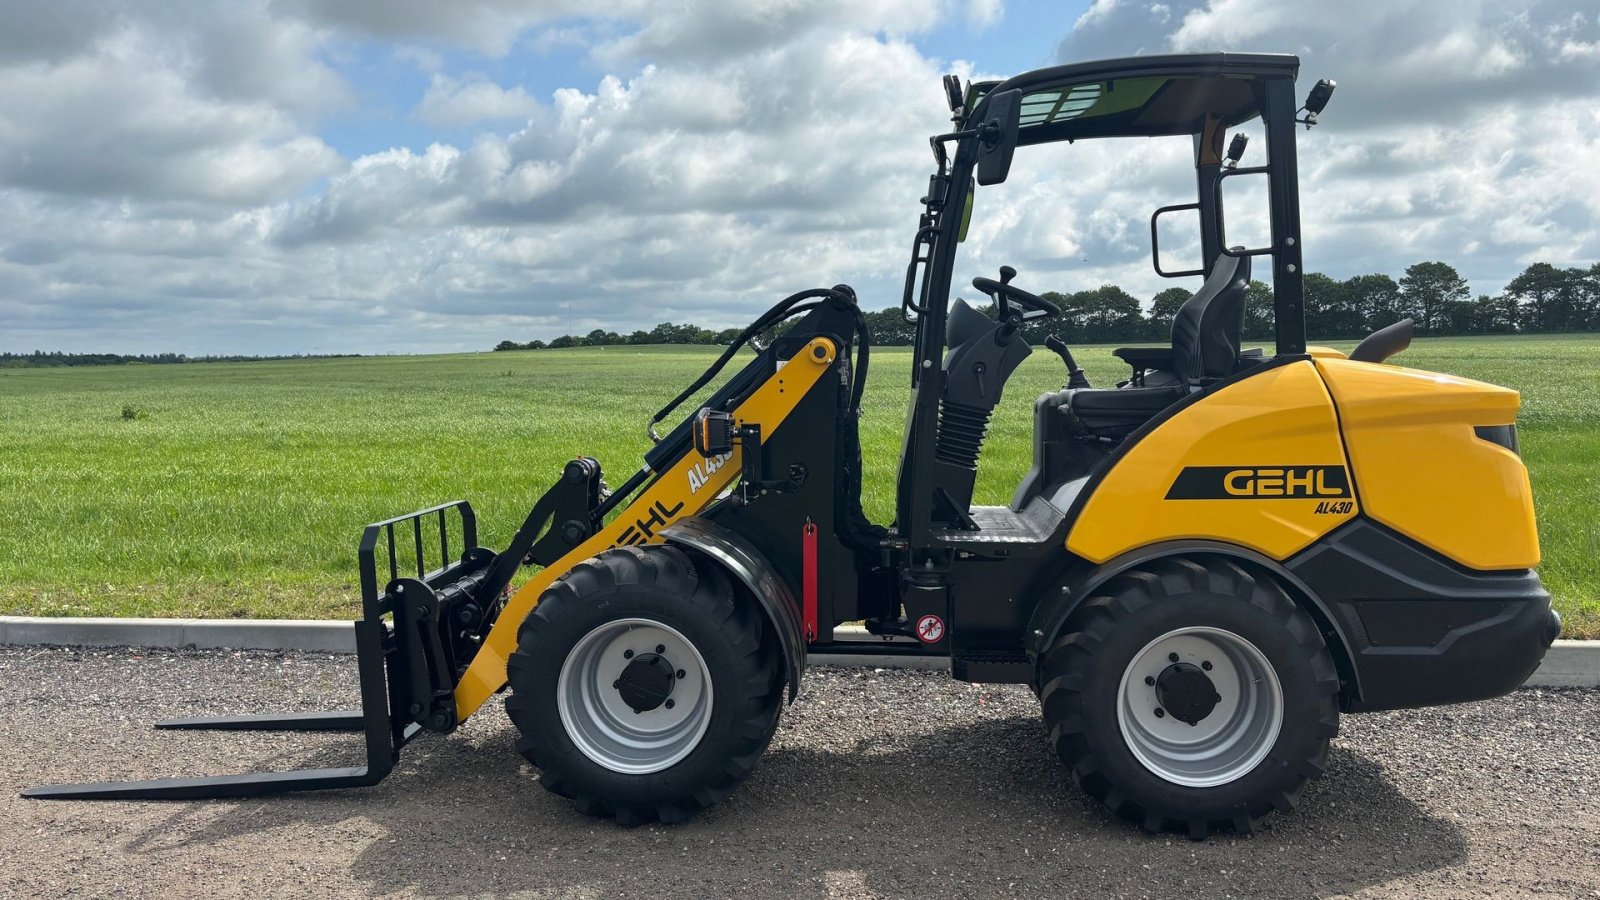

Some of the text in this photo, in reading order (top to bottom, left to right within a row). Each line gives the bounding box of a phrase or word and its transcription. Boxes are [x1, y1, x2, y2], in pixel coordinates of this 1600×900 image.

[1223, 469, 1343, 496] GEHL
[1314, 501, 1354, 515] AL430
[606, 500, 685, 550] EHL
